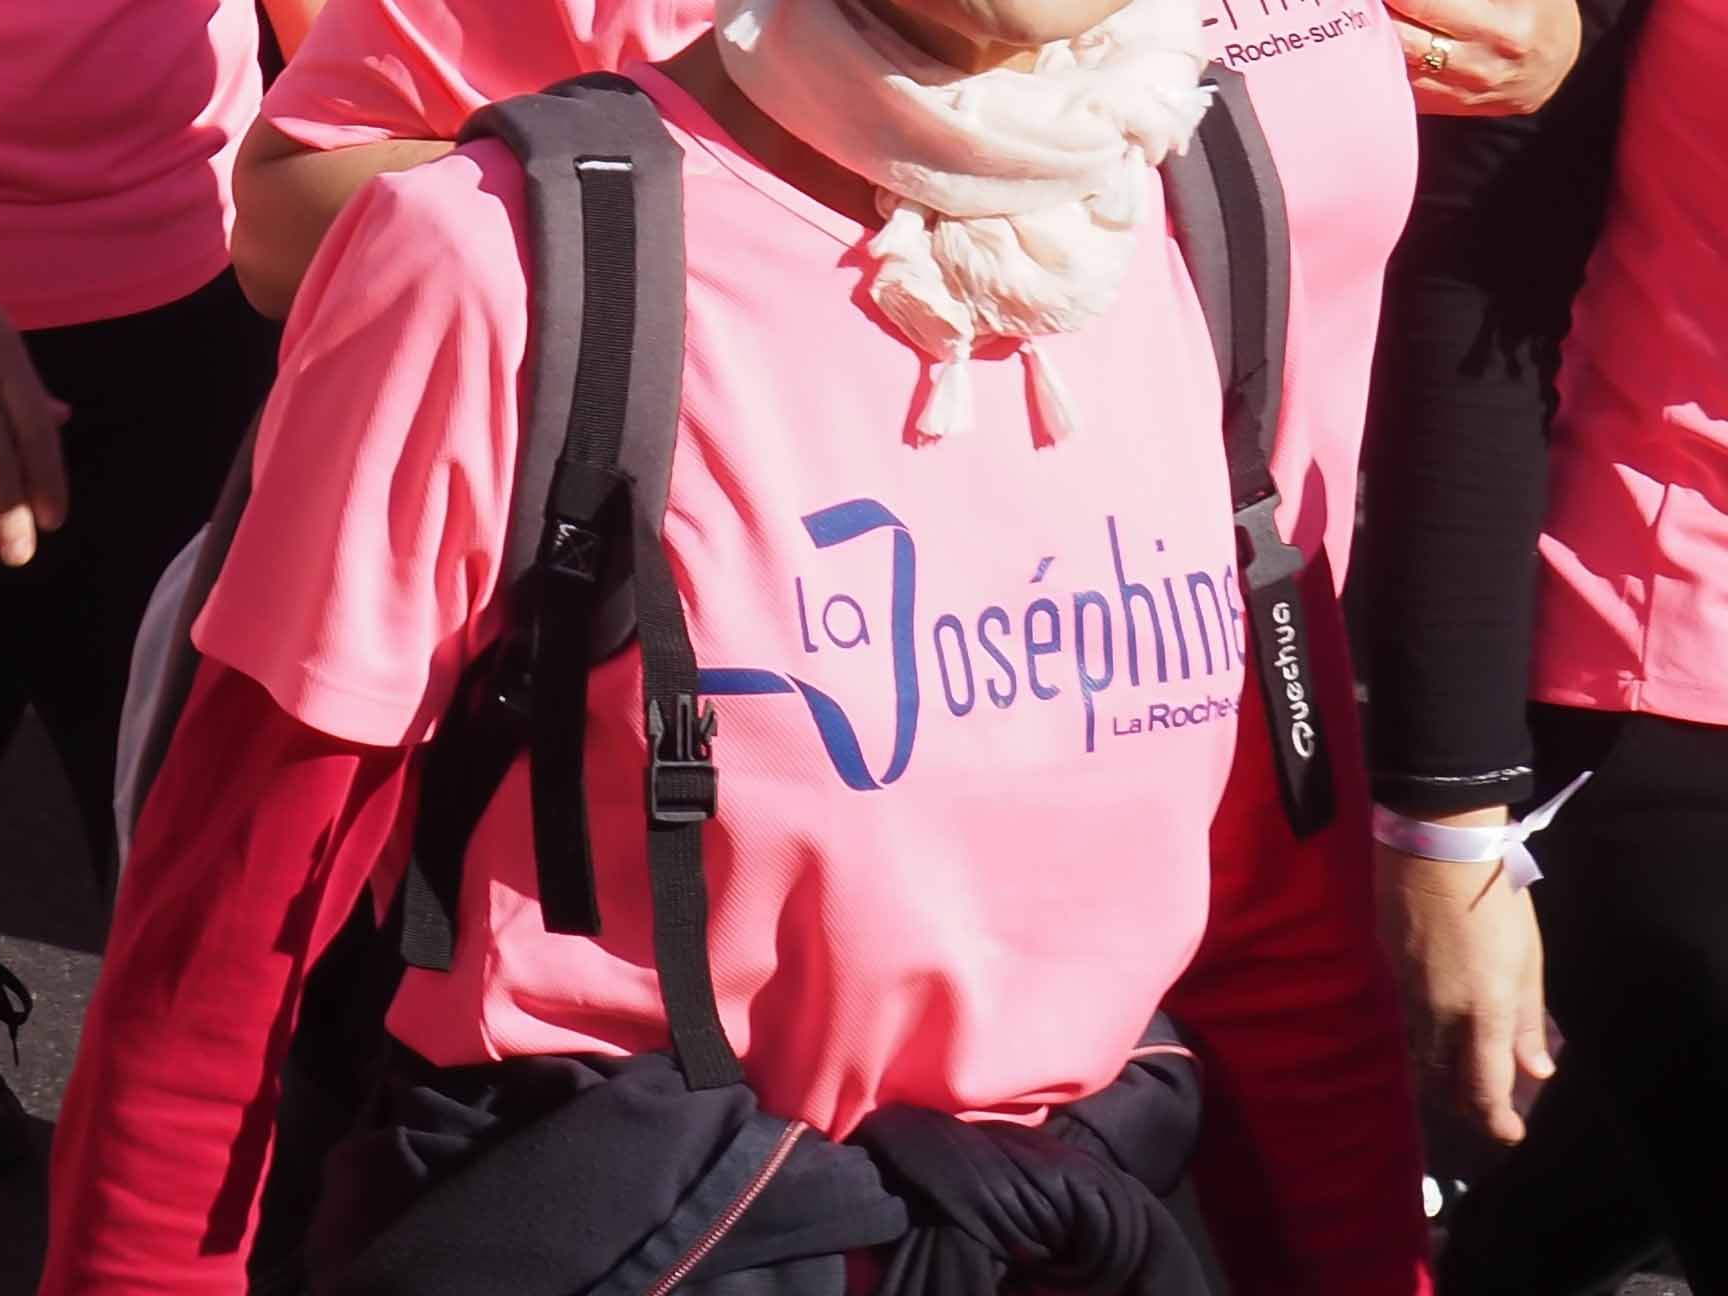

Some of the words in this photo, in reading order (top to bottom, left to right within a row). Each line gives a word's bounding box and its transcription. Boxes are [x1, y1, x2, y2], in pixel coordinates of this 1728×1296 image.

[794, 575, 872, 655] la
[1271, 600, 1317, 761] Quechua
[1112, 713, 1143, 738] La
